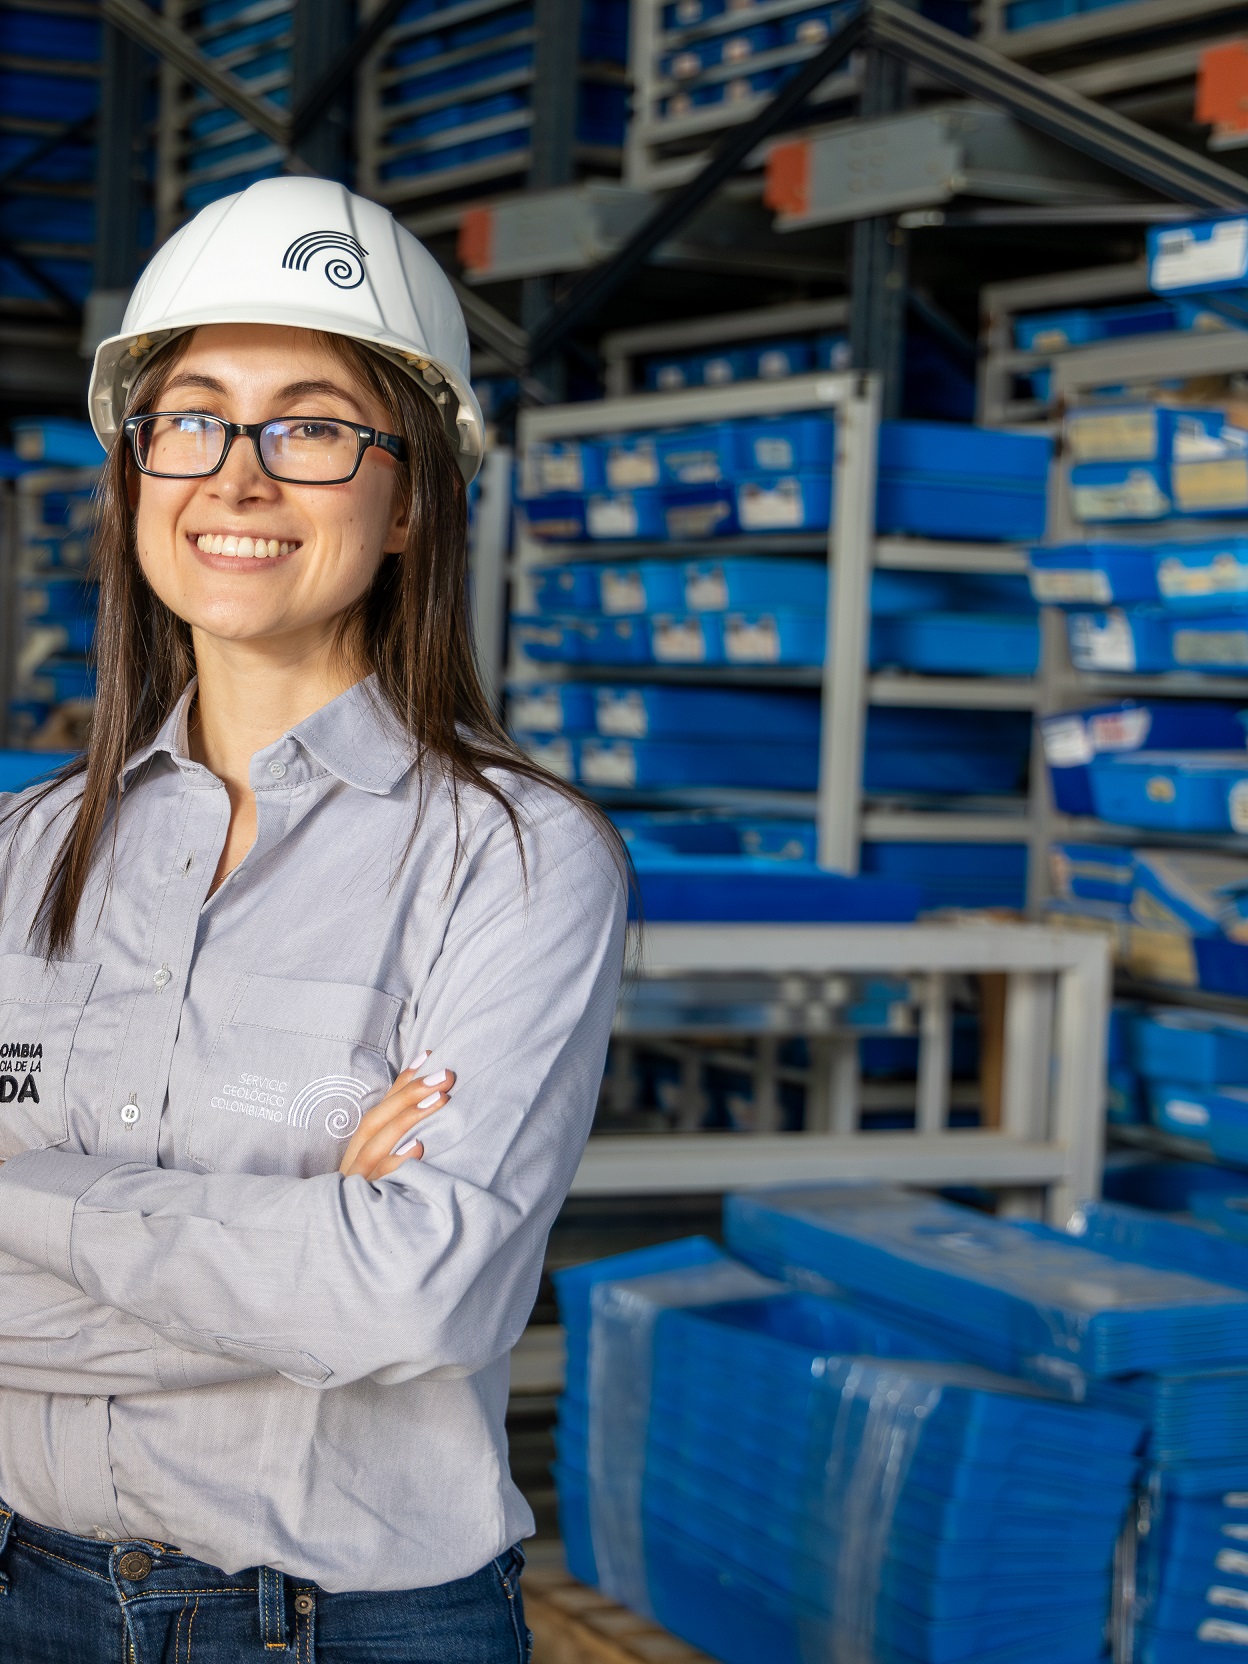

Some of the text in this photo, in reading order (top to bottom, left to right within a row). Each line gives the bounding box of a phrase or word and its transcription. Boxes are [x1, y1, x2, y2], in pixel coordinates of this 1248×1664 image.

[14, 1061, 27, 1072] DE
[30, 1061, 41, 1073] LA
[211, 1097, 282, 1122] COLOMBIANO
